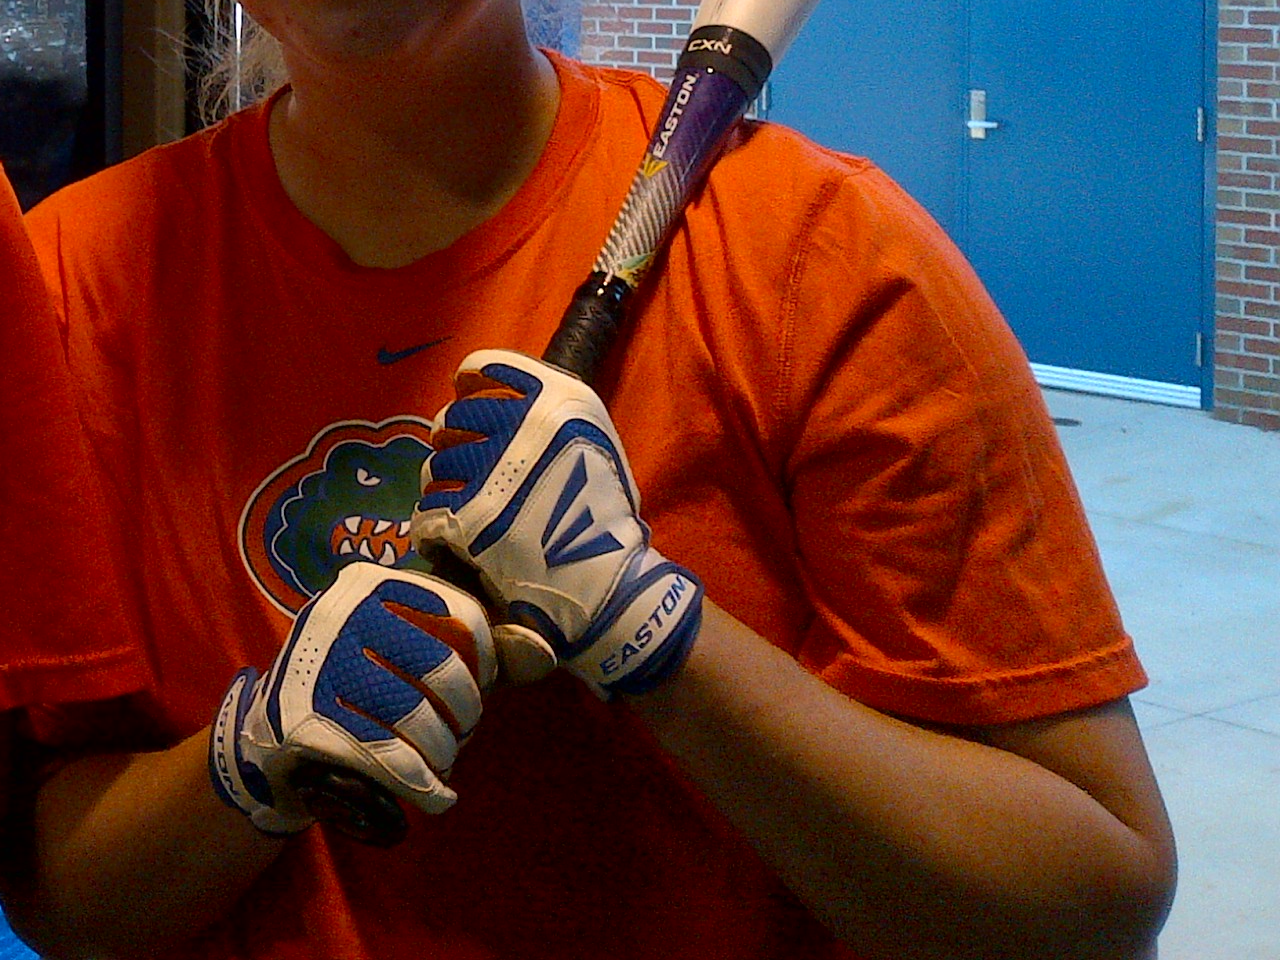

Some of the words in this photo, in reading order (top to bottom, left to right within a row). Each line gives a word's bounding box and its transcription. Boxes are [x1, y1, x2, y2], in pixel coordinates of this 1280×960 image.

[687, 39, 732, 56] CXN
[651, 73, 699, 160] EASTON
[598, 574, 689, 677] EASTON
[217, 678, 244, 797] ASTON
